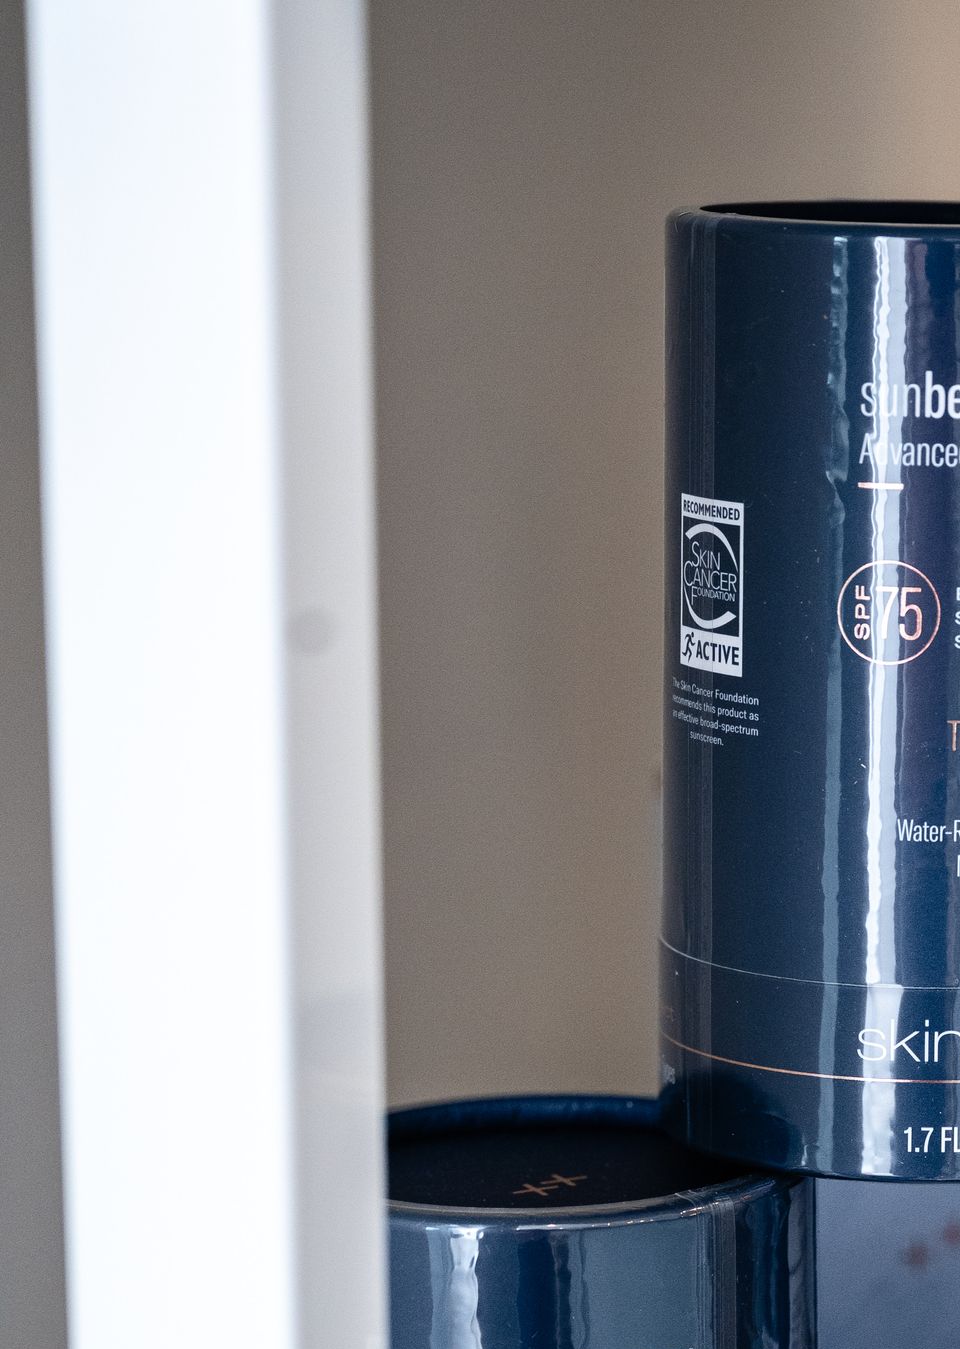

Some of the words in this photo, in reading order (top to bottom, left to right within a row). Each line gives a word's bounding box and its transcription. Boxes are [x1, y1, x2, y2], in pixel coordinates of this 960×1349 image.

[683, 499, 740, 521] RECOMMENDED
[691, 541, 721, 571] SKIN
[683, 560, 737, 592] CANCER
[854, 585, 874, 641] SPF
[875, 586, 922, 641] 75
[696, 639, 740, 666] ACTIVE
[680, 679, 692, 692] Skin
[691, 683, 714, 698] Cancer
[715, 689, 760, 706] Foundation
[703, 702, 716, 714] this
[717, 707, 747, 720] product
[748, 712, 760, 722] as
[689, 730, 724, 746] sunscreen.
[700, 715, 759, 737] broad-spectrum
[903, 1125, 934, 1153] 1.7
